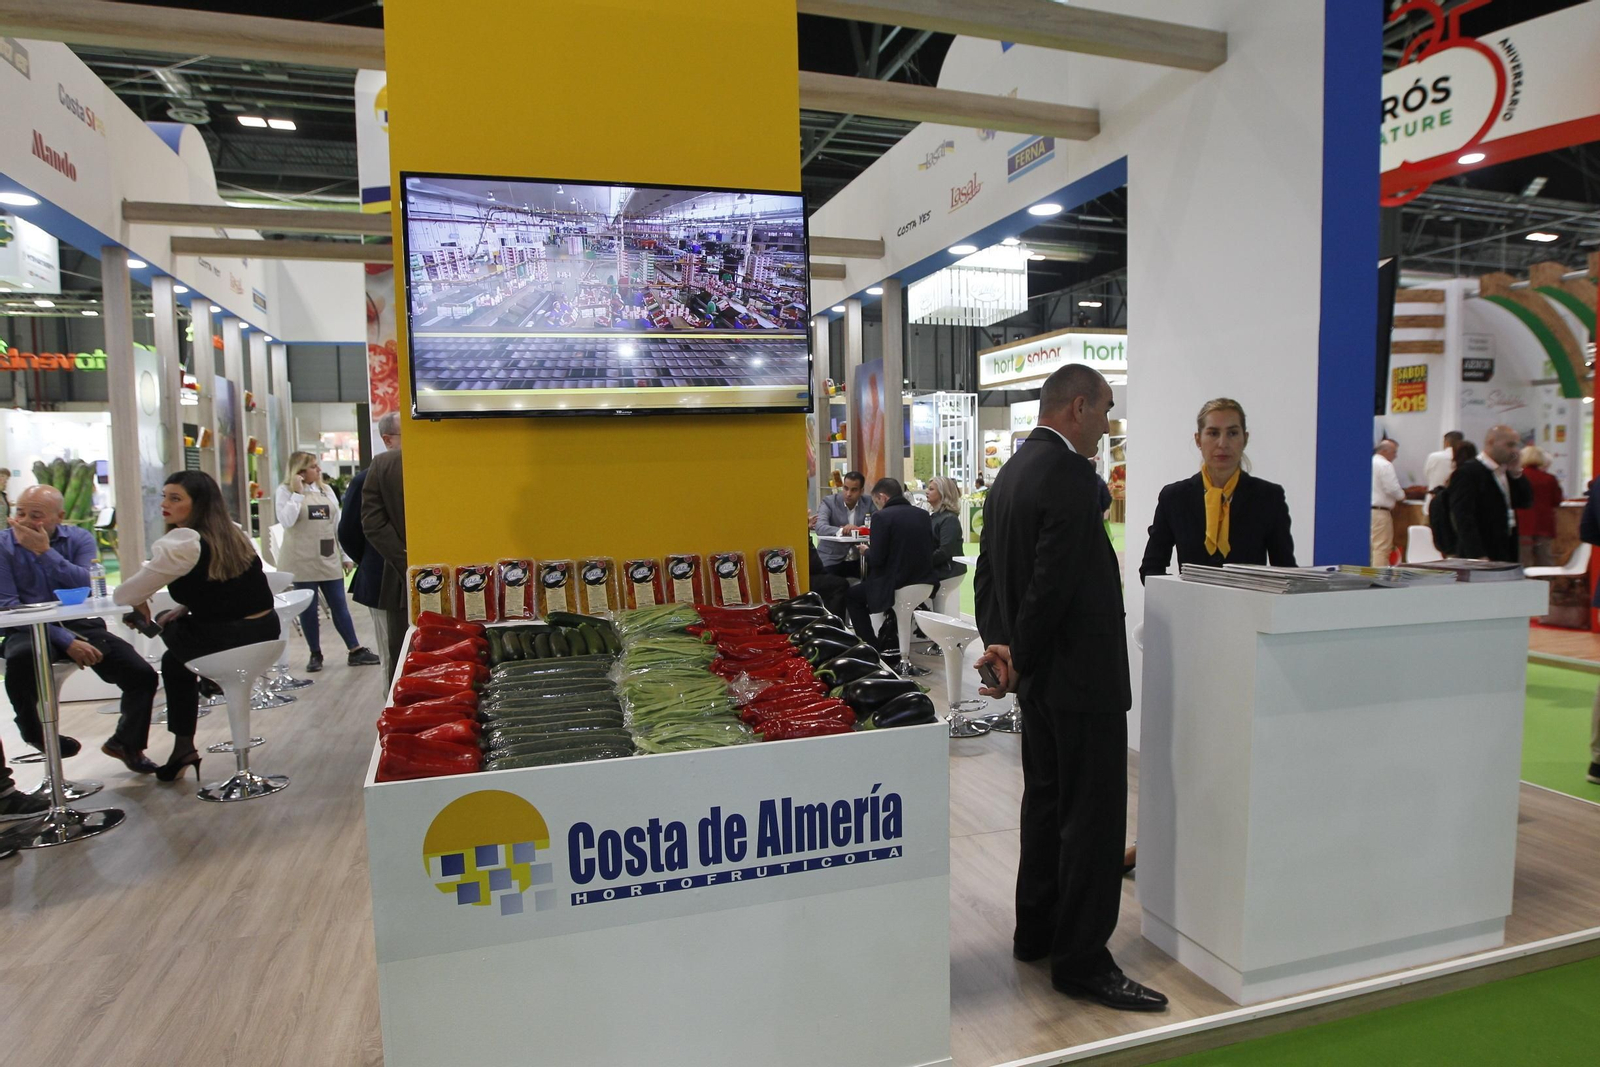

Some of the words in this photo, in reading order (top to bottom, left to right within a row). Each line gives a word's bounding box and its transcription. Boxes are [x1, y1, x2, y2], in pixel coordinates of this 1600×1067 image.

[1498, 37, 1524, 122] ANIVERSARIO
[58, 82, 85, 123] Costa
[32, 128, 77, 182] Mando
[1014, 139, 1047, 170] FERNA
[896, 219, 917, 237] COSTA
[919, 209, 932, 225] YES
[1083, 340, 1124, 361] hort
[1392, 393, 1428, 413] 2019
[567, 818, 689, 886] Costa
[698, 806, 748, 866] de
[756, 783, 903, 859] Almería
[573, 847, 901, 905] HORTOFRUTICOLA
